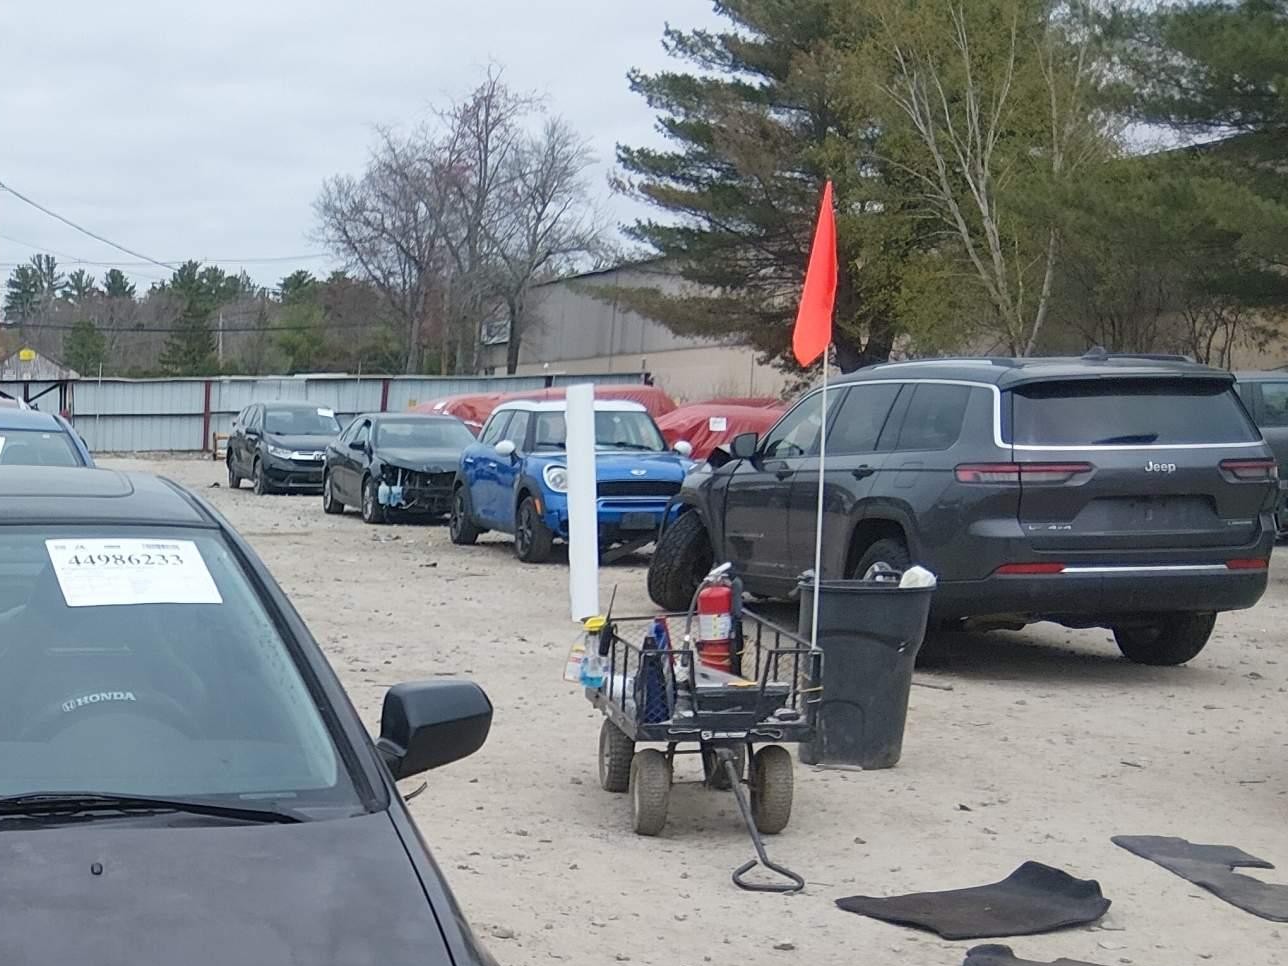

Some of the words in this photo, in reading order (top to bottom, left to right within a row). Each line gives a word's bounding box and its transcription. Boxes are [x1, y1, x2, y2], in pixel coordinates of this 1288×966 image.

[1144, 460, 1177, 474] Jeep
[67, 553, 184, 567] 44986233
[75, 691, 137, 706] HONDA
